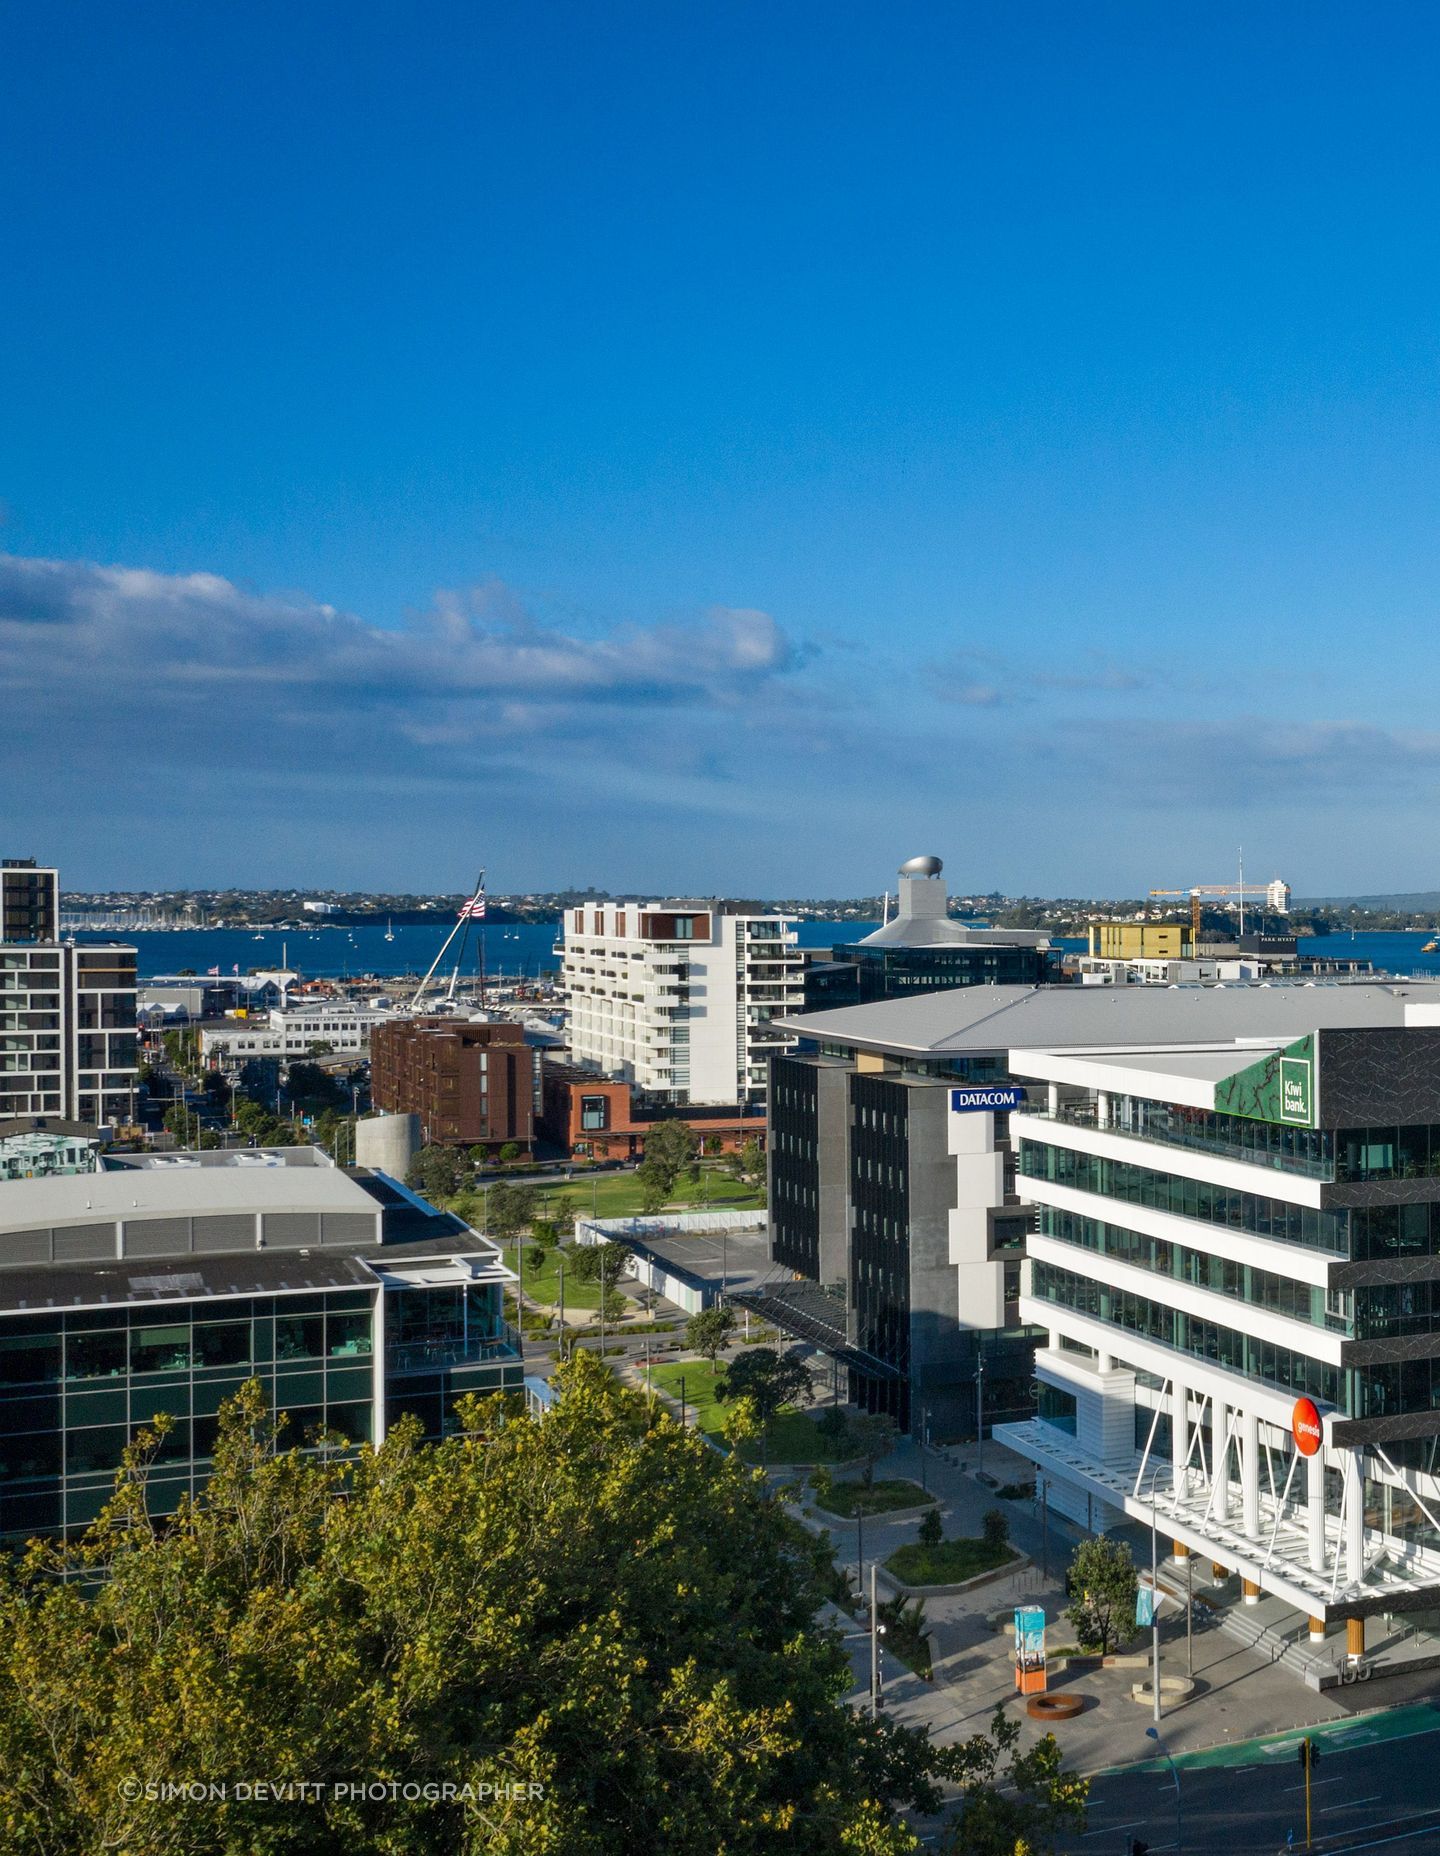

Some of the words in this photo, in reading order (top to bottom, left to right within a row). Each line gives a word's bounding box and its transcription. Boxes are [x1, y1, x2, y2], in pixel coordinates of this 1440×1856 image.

[1285, 1080, 1302, 1096] Kiwi
[960, 1092, 1015, 1106] DATACOM
[1298, 1422, 1320, 1438] genesis
[1338, 1659, 1371, 1685] 155
